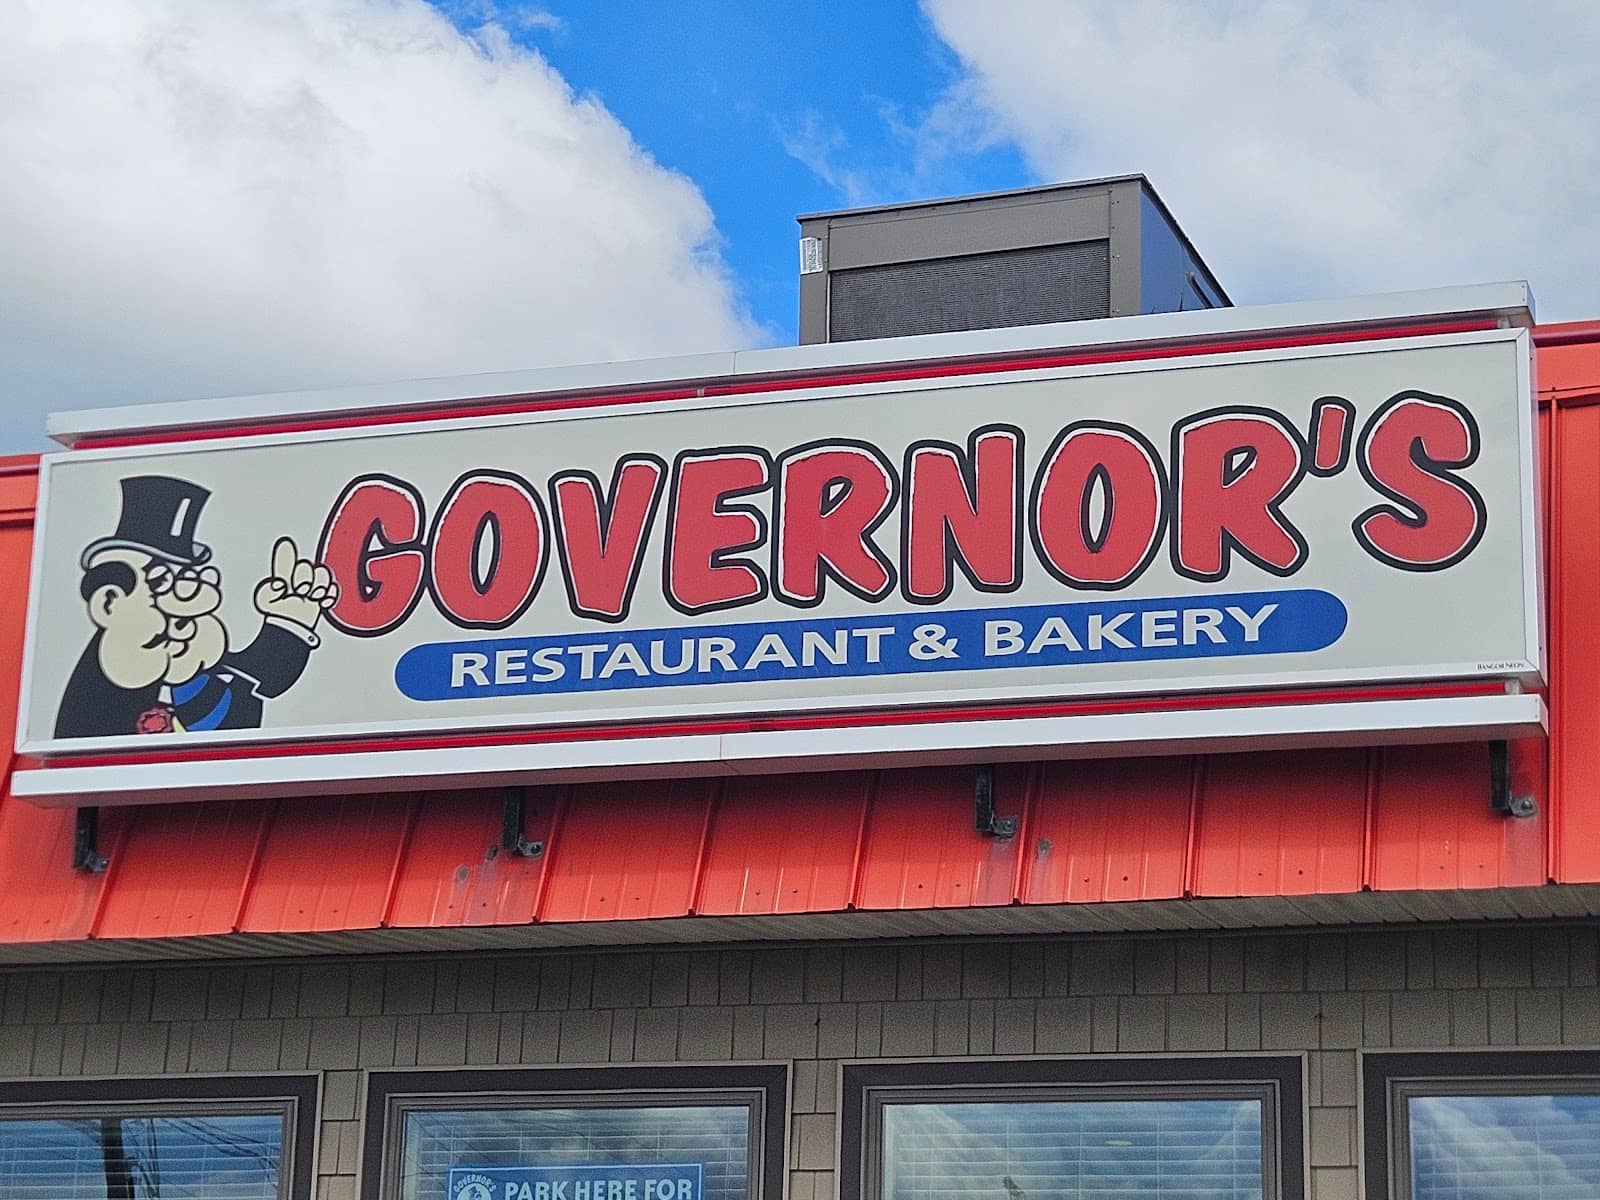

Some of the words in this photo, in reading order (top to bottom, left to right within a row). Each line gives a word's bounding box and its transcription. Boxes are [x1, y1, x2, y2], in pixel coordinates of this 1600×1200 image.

[320, 389, 1487, 636] GOVERNOR'S
[450, 627, 895, 688] RESTAURANT
[908, 624, 960, 660] &
[983, 604, 1279, 657] BAKERY
[453, 1174, 497, 1193] GOVERNOR'S
[505, 1181, 568, 1200] PARK
[575, 1180, 637, 1200] HERE
[645, 1179, 692, 1200] FOR
